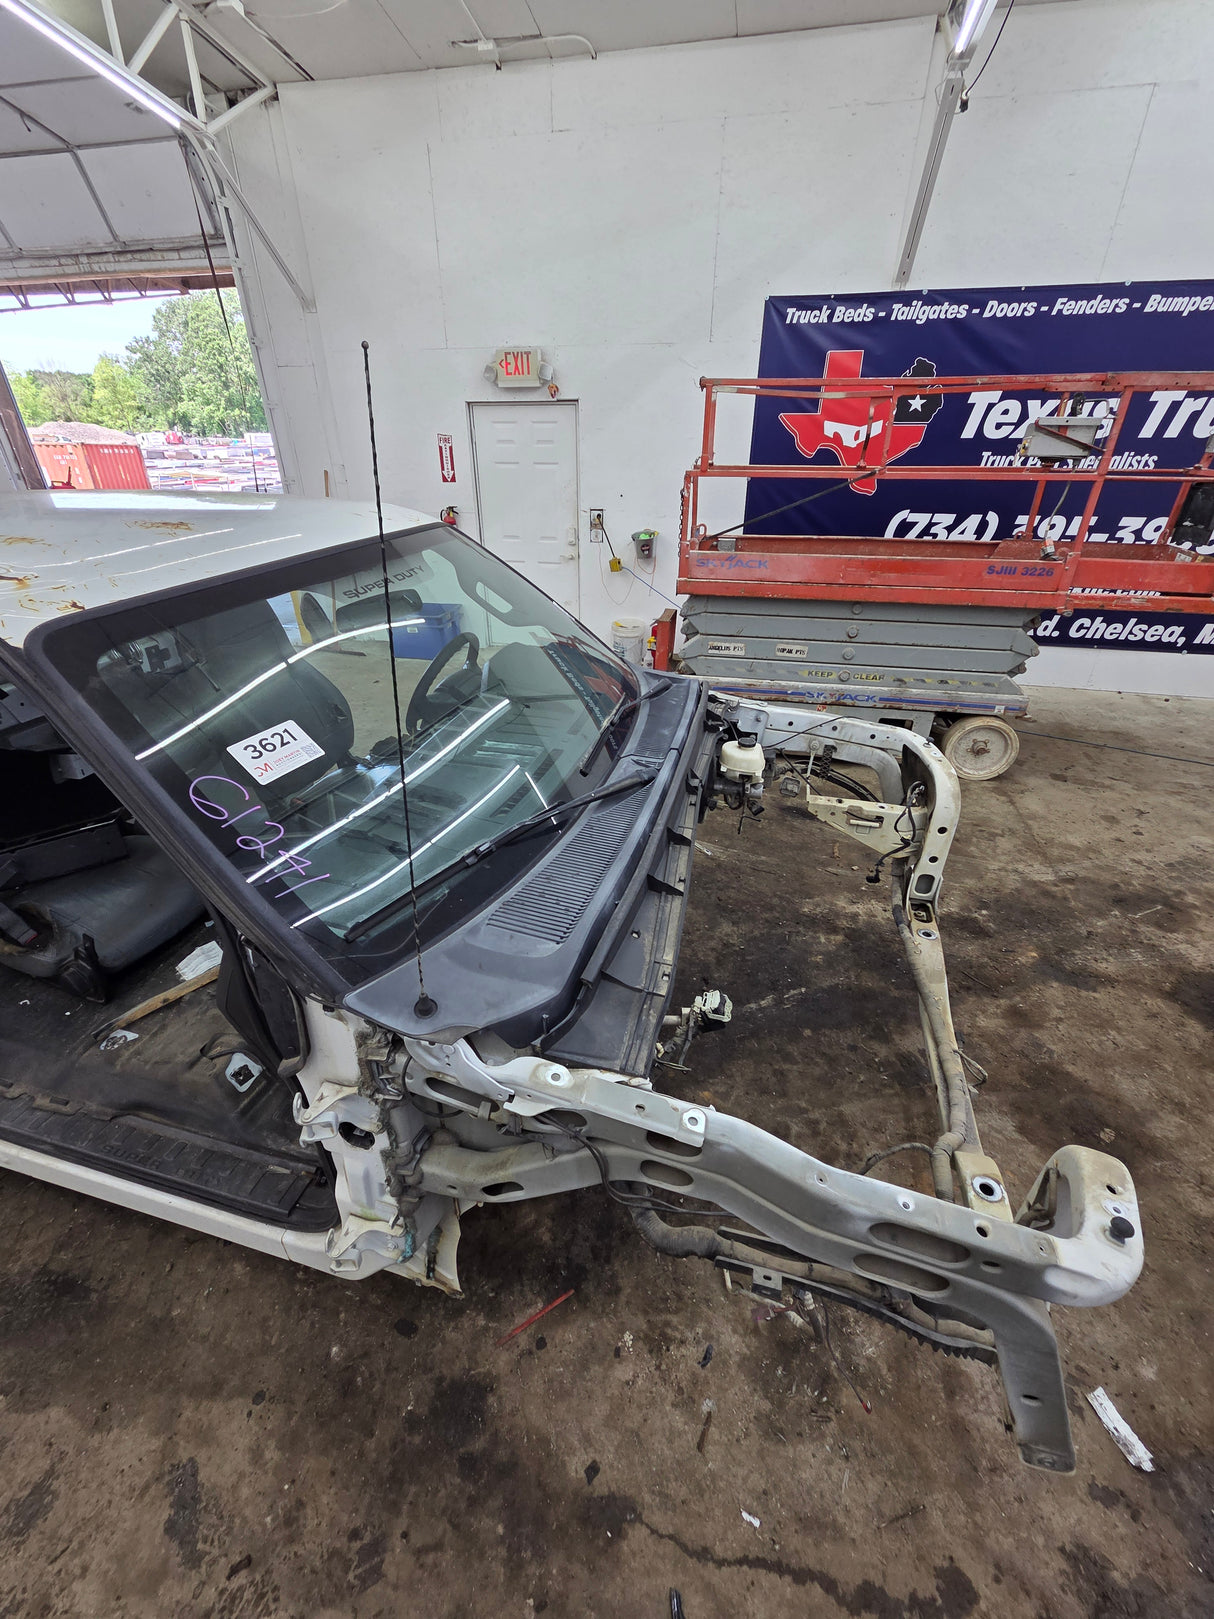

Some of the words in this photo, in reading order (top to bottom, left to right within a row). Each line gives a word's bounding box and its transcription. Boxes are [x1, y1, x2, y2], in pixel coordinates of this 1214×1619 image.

[785, 305, 831, 324] Truck
[832, 303, 875, 323] Beds
[890, 300, 969, 325] Tailgates
[982, 300, 1038, 318] Doors
[1051, 295, 1130, 316] Fenders
[504, 351, 532, 376] EXIT
[884, 509, 999, 541] (734)
[392, 564, 425, 582] DUTY
[696, 556, 769, 569] SKYJACK
[1021, 566, 1055, 577] 3226
[1027, 614, 1061, 638] d.
[1068, 616, 1187, 648] Chelsea,
[807, 670, 833, 678] KEEP
[243, 728, 298, 760] 3621
